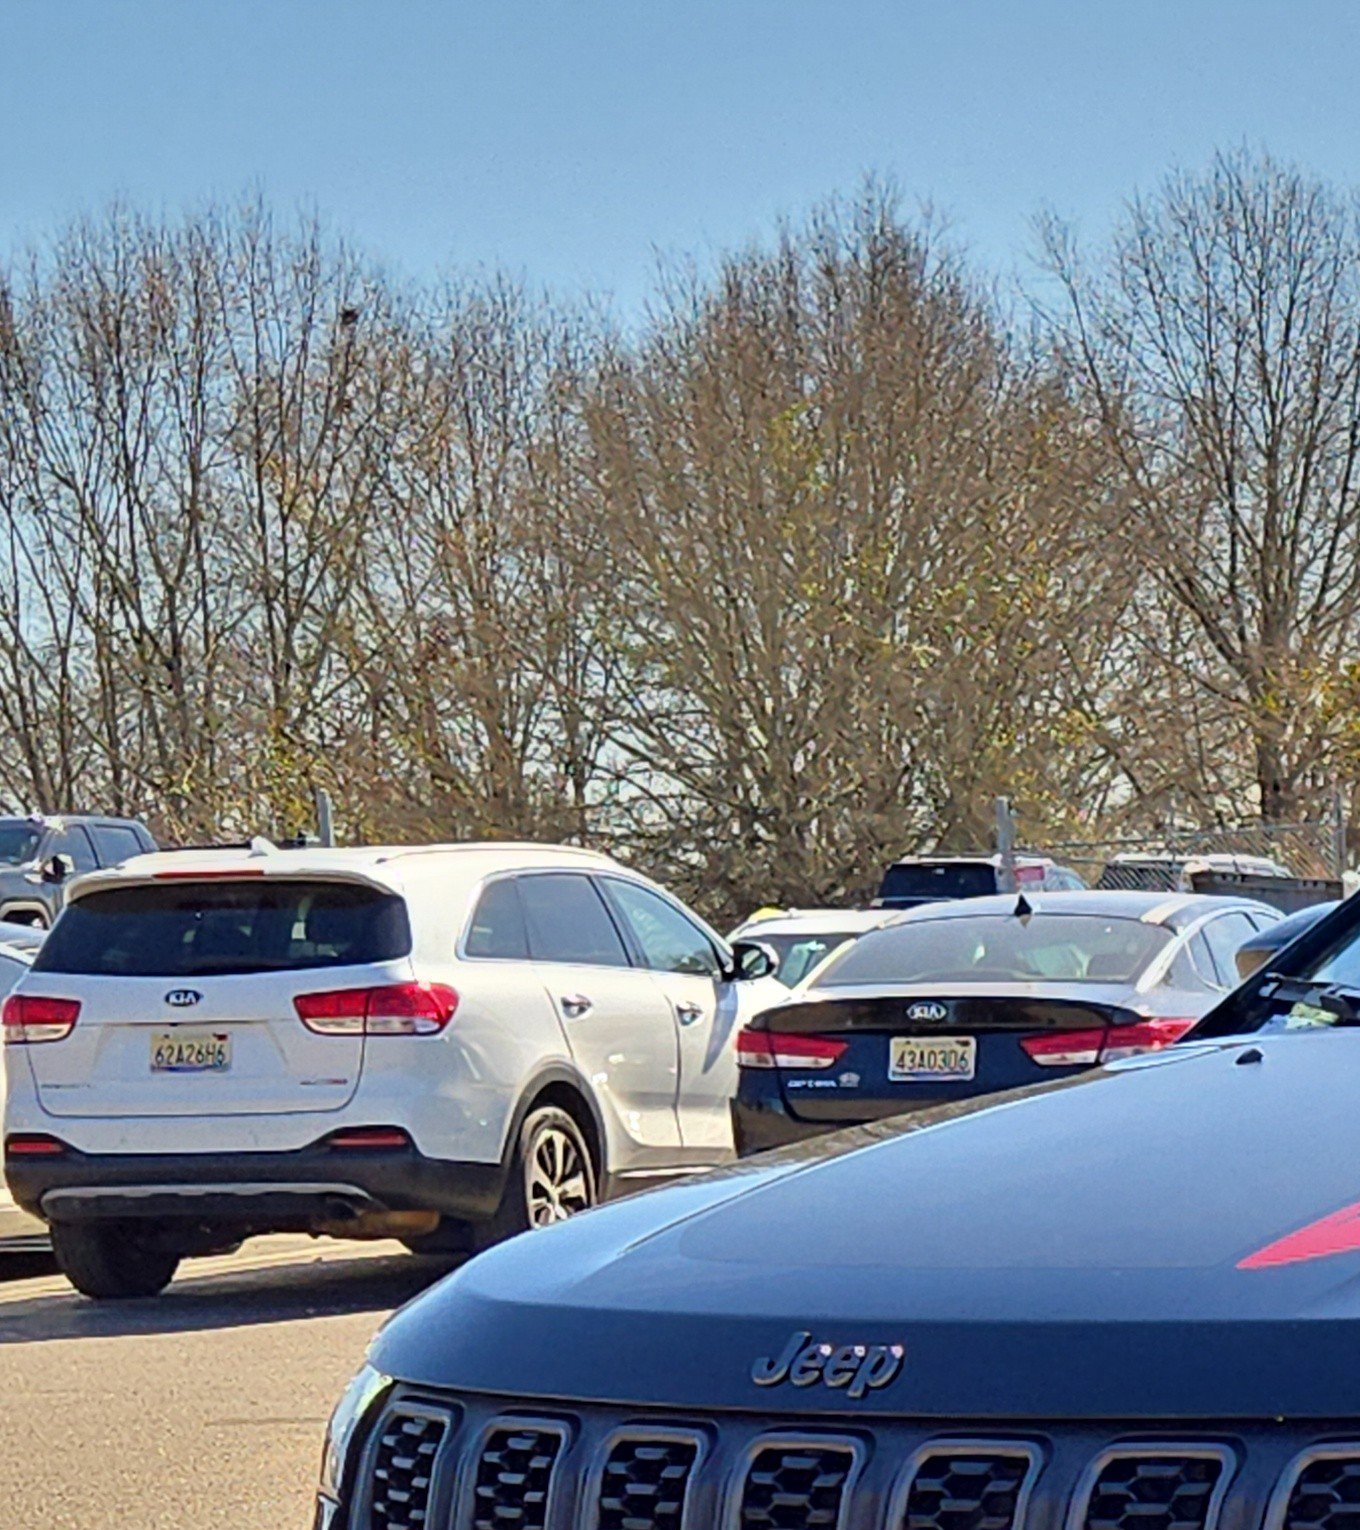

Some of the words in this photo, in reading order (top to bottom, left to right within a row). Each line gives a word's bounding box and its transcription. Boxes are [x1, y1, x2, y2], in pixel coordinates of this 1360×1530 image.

[167, 990, 199, 1006] KIA
[908, 1003, 945, 1019] KIA
[751, 1331, 904, 1398] Jeep
